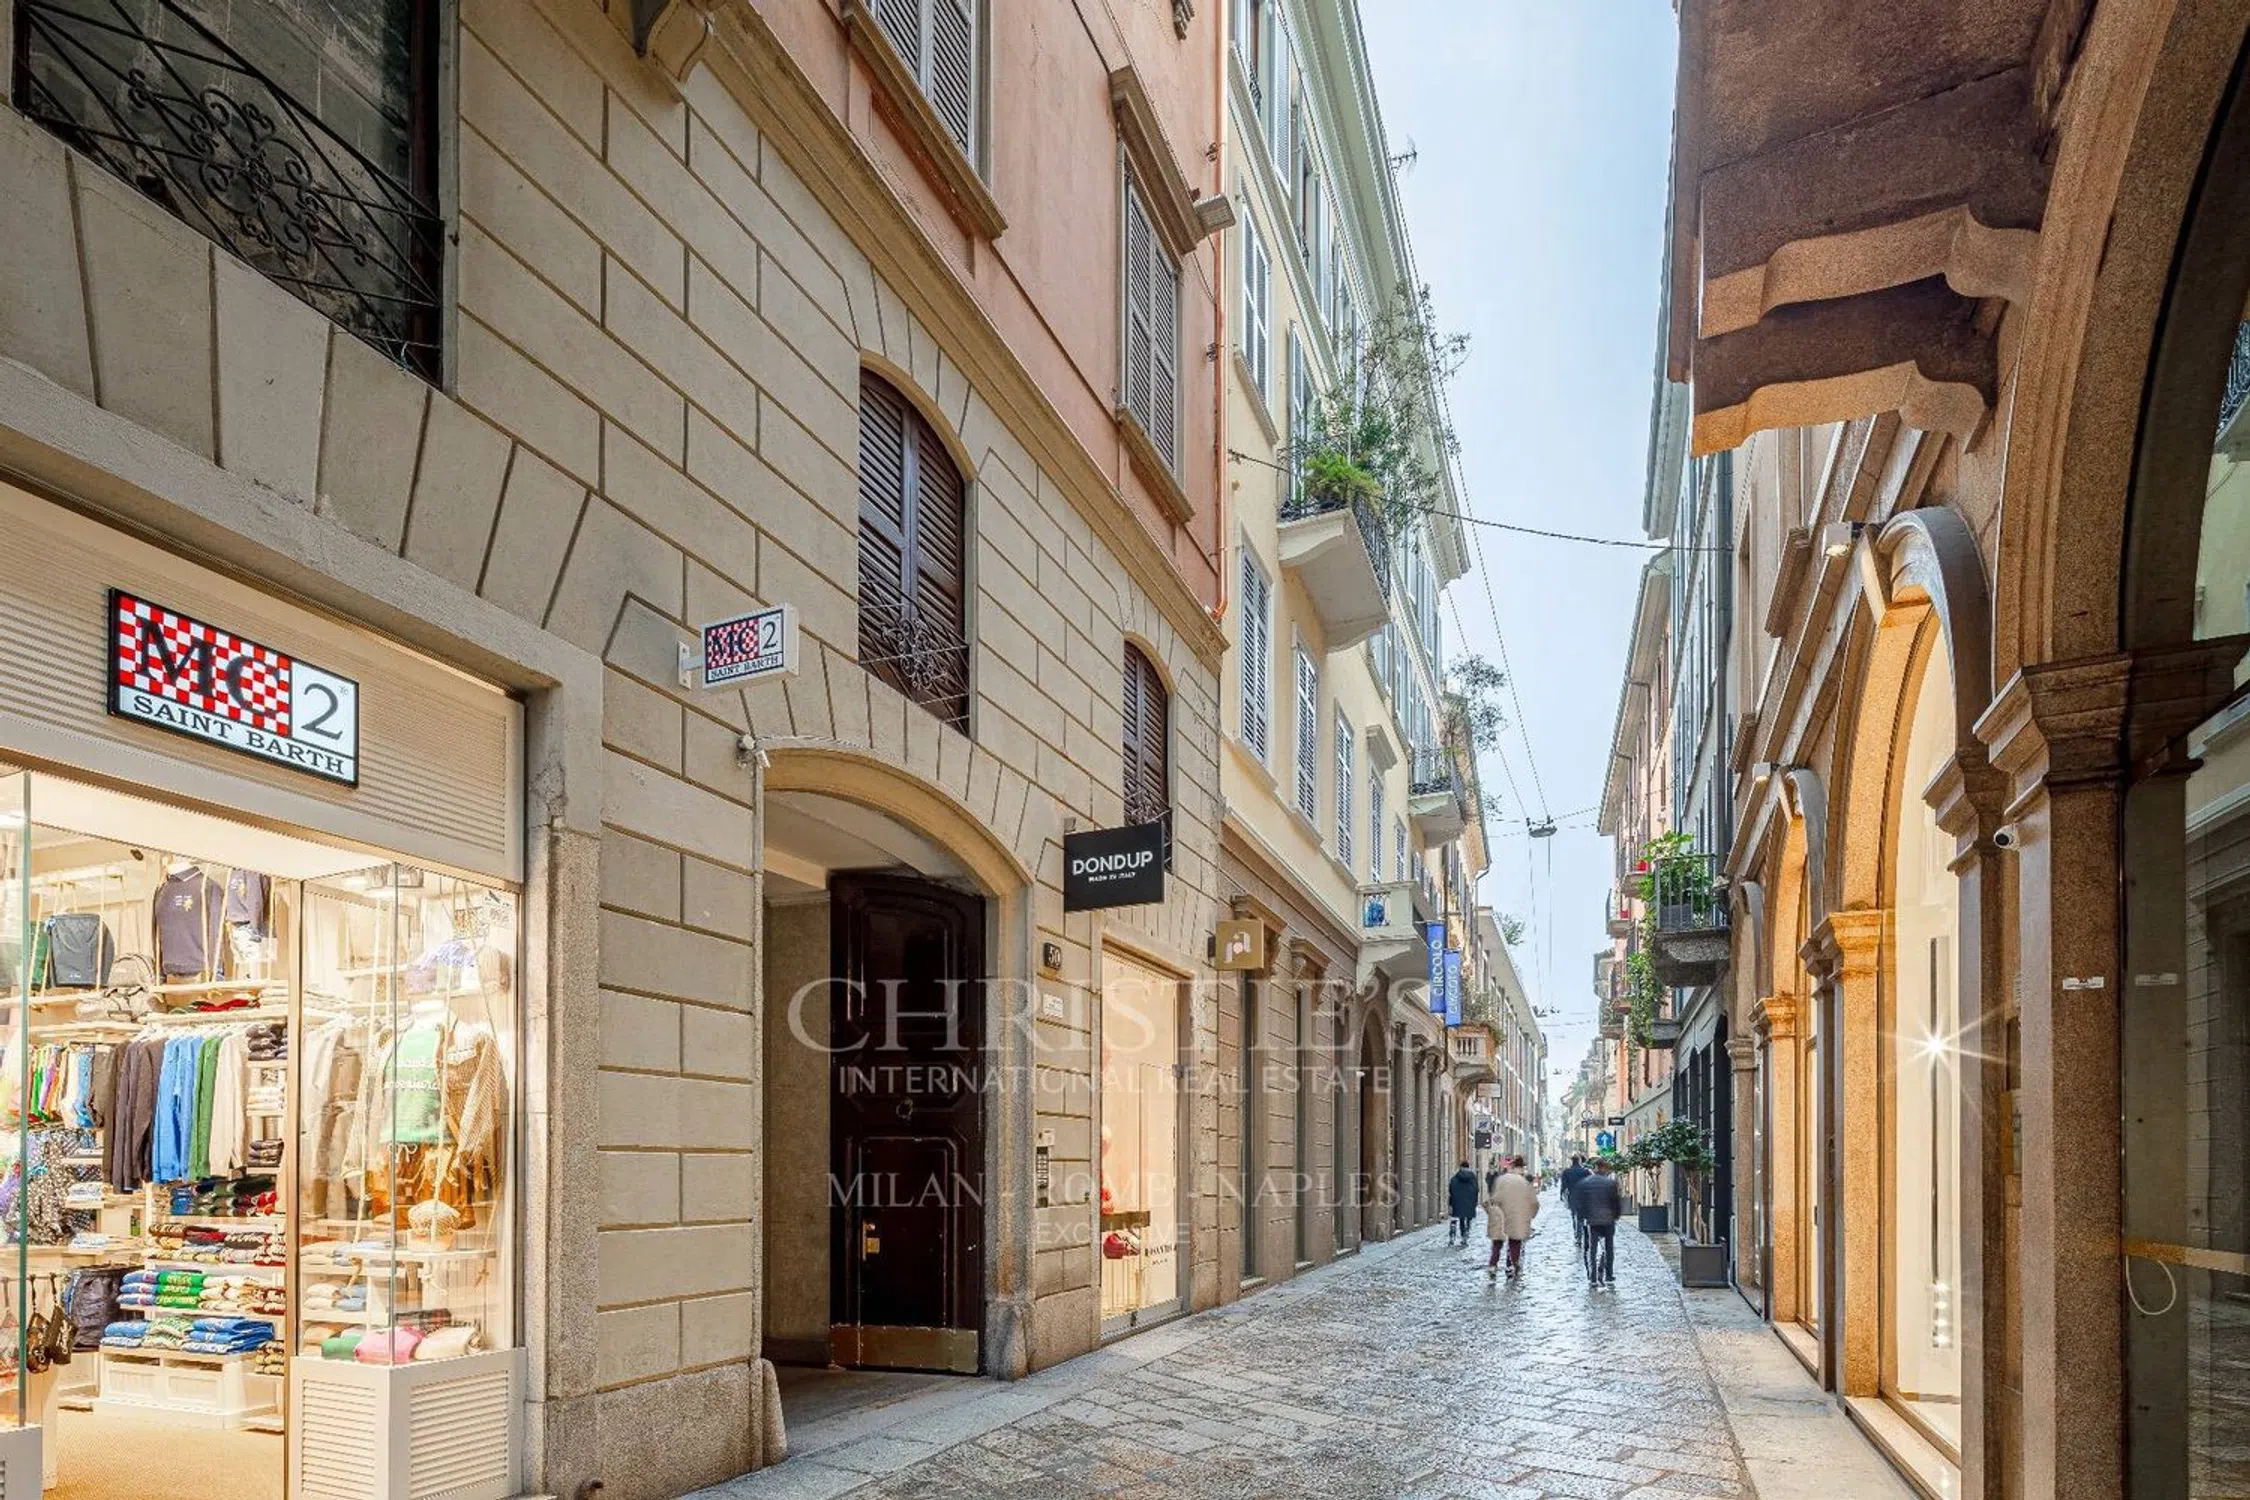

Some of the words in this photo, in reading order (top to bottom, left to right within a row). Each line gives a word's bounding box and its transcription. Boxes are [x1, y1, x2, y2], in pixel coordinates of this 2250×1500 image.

[711, 663, 741, 679] SAINT
[744, 654, 779, 672] BARTH
[133, 694, 233, 739] SAINT
[246, 729, 345, 776] BARTH
[1072, 850, 1154, 876] DONDUP
[1048, 945, 1062, 968] 50
[1431, 940, 1444, 997] CIRCOLO
